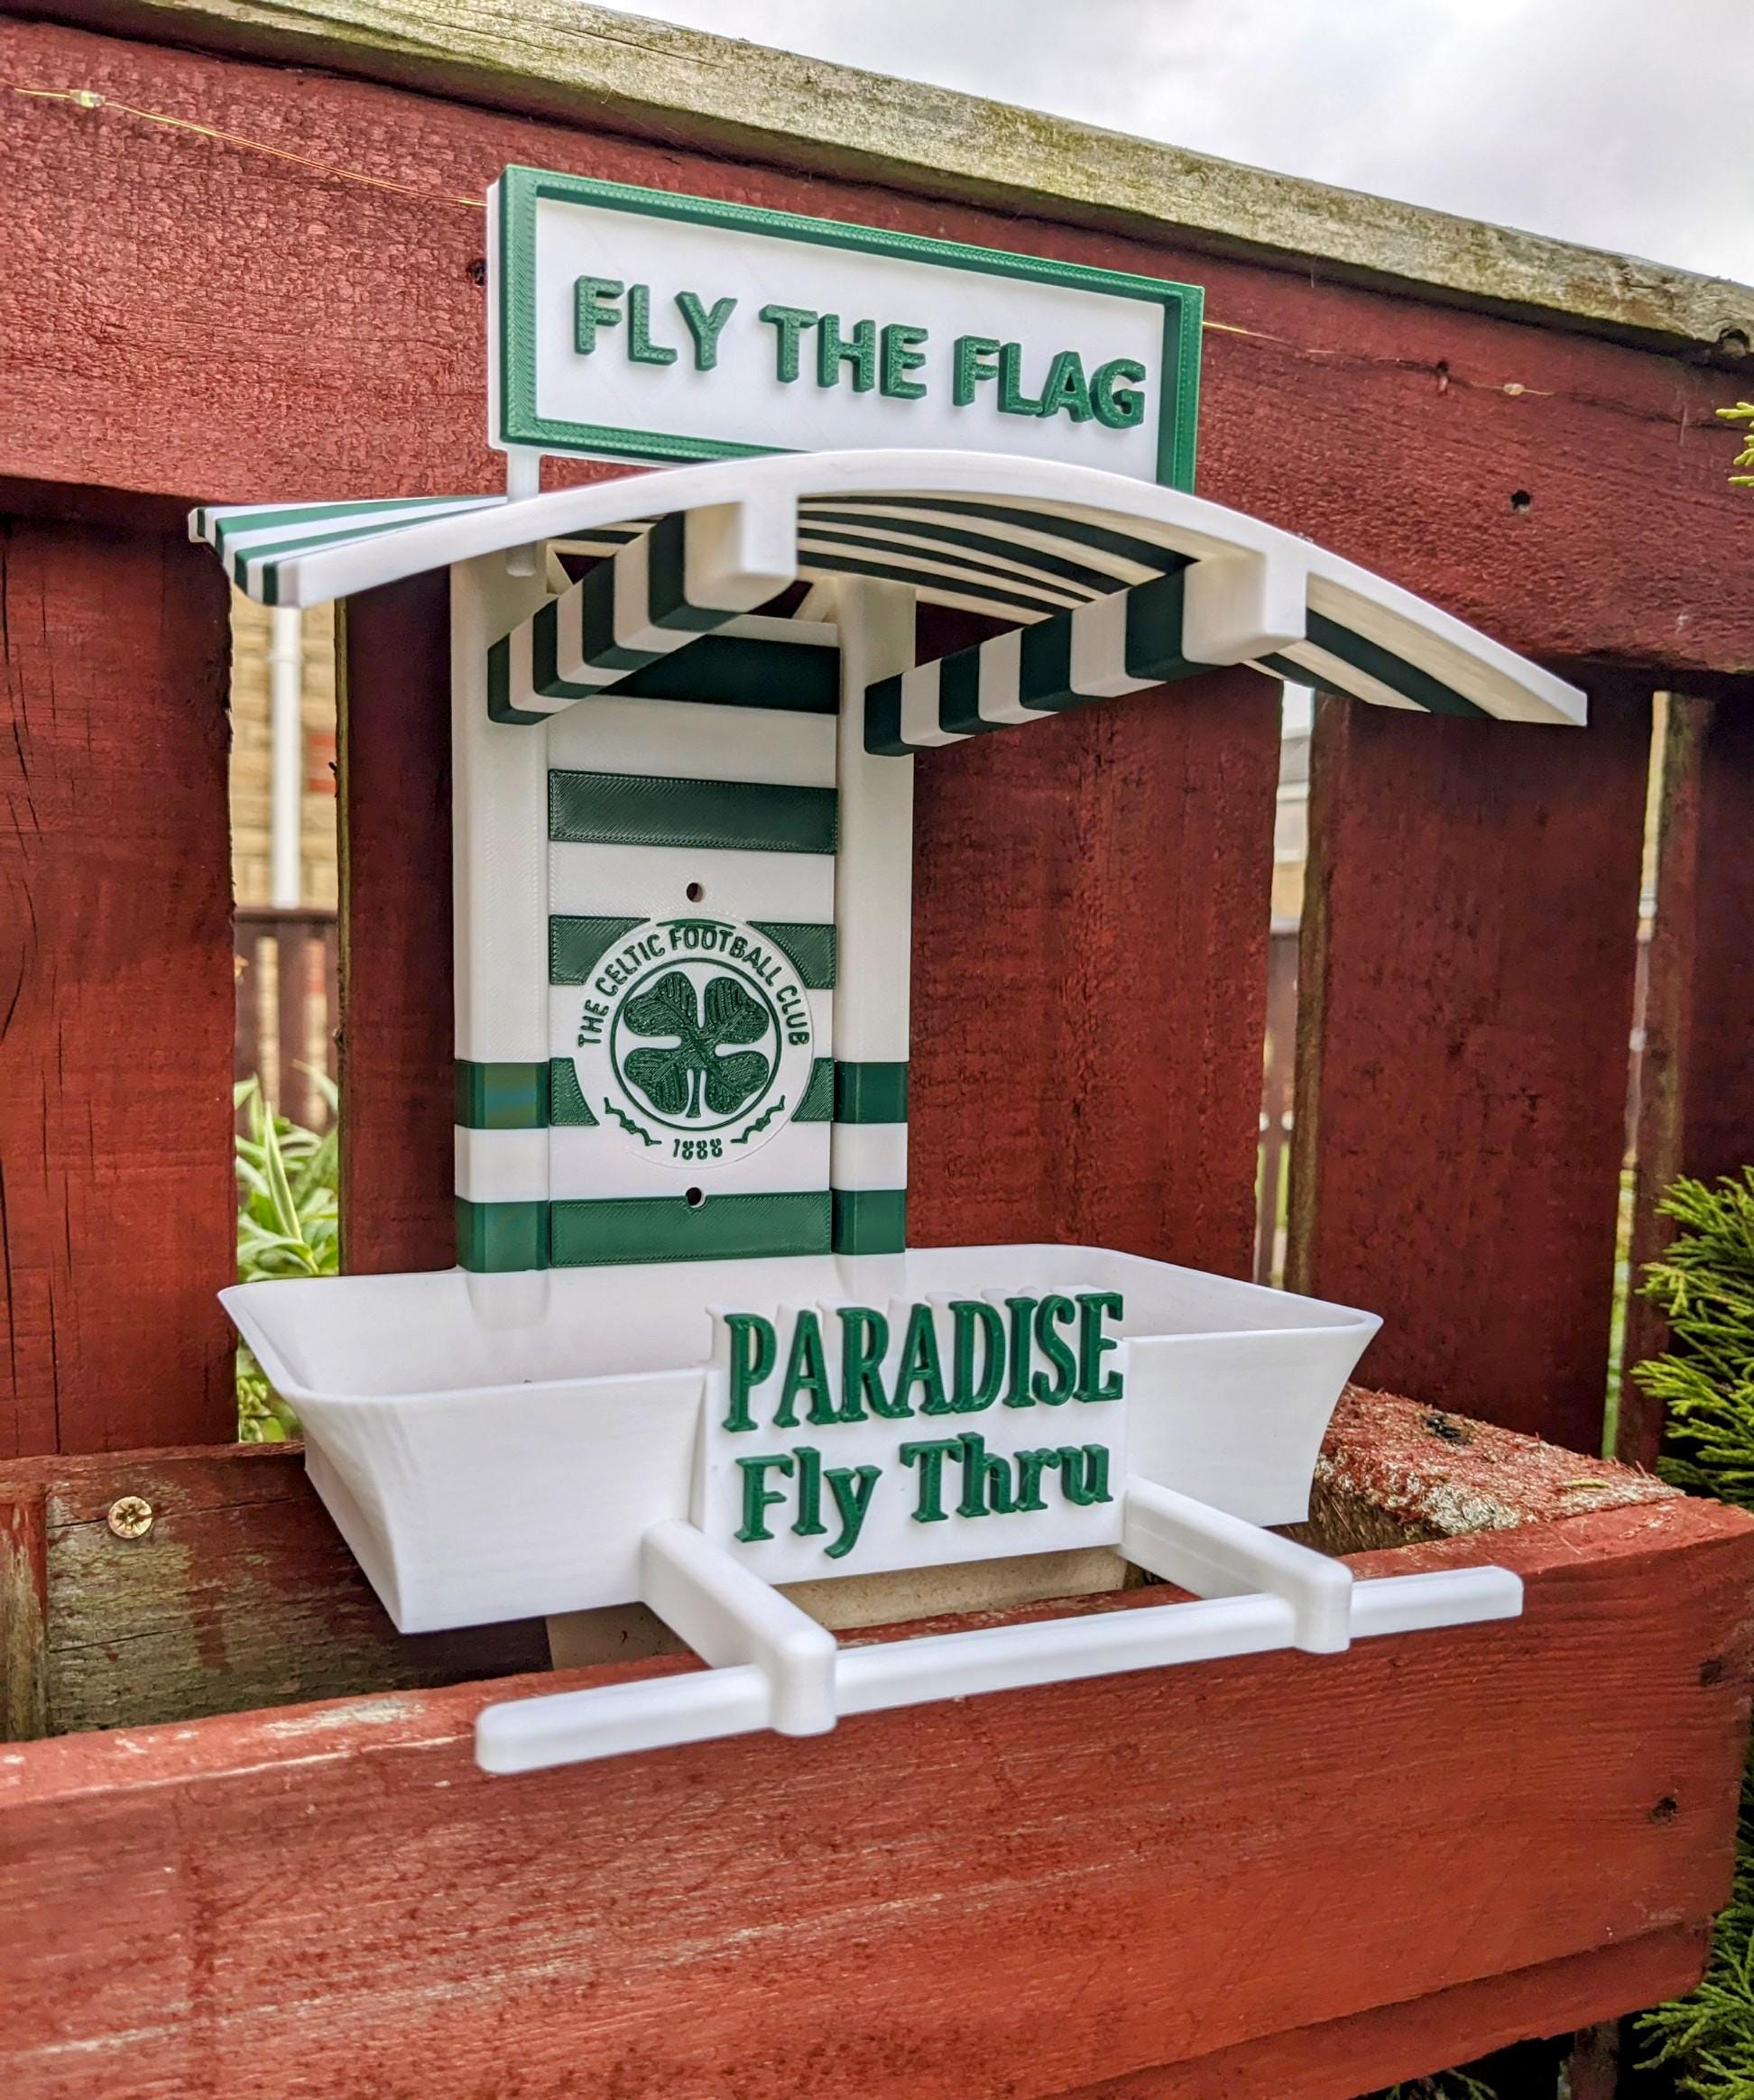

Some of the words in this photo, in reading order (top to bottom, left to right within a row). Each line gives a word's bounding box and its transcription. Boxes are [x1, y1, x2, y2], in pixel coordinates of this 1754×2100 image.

[574, 274, 738, 372] FLY
[759, 303, 928, 401] THE
[953, 335, 1148, 429] FLAG
[577, 999, 610, 1048] THE
[595, 934, 666, 997] CELTIC
[669, 926, 782, 987] FOOTBALL
[776, 984, 810, 1046] CLUB
[673, 1138, 724, 1161] 1888
[722, 1291, 1124, 1433] PARADISE
[734, 1445, 883, 1560] Fly
[900, 1431, 1114, 1524] Thru
